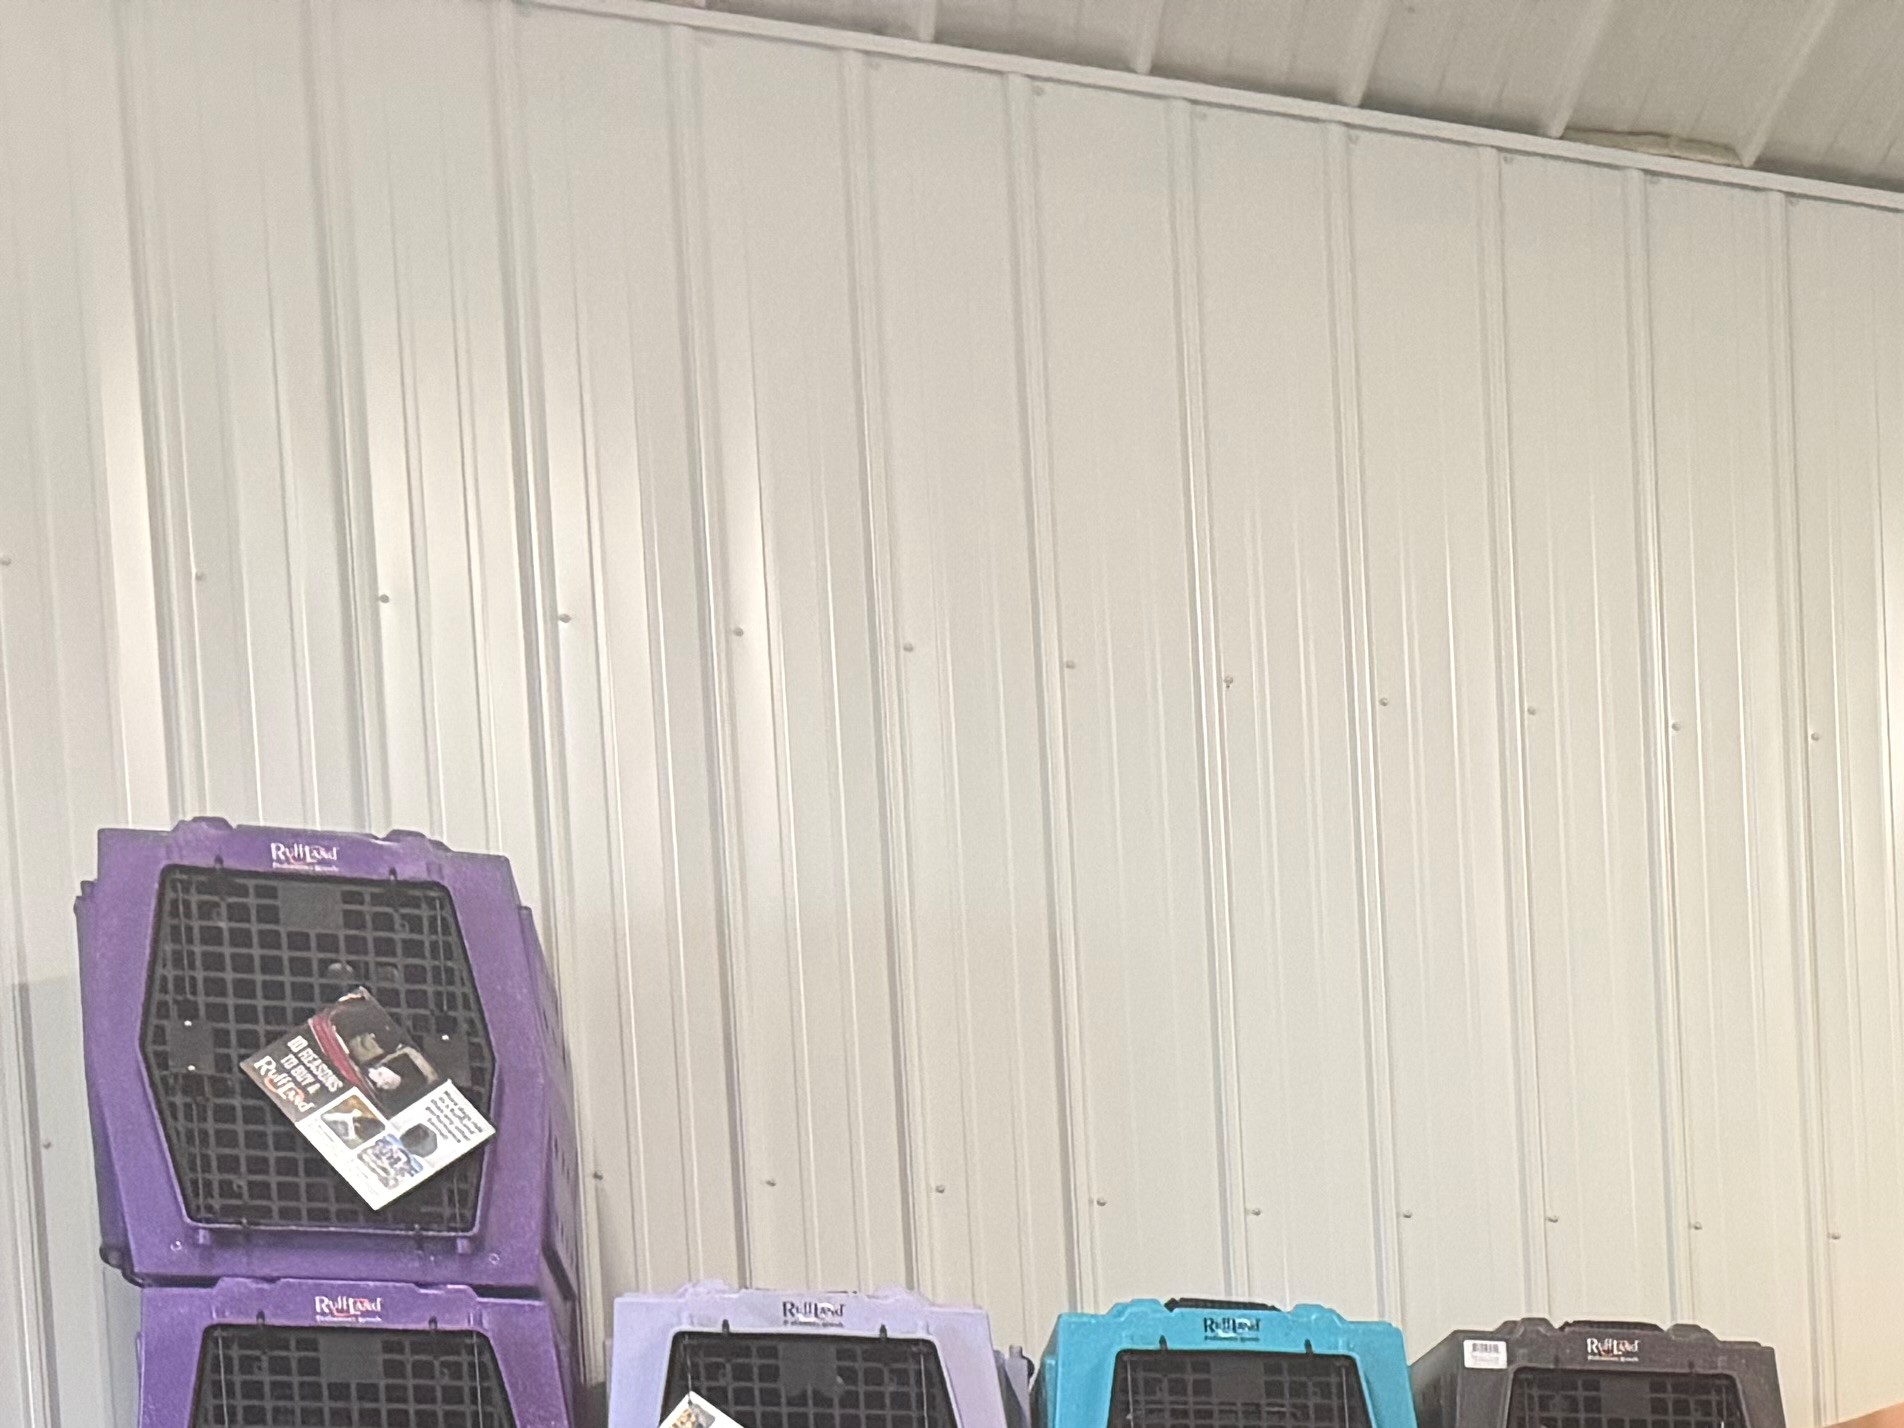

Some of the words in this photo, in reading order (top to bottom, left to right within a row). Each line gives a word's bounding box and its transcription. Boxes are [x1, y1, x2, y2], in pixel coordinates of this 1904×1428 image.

[286, 1034, 309, 1053] 10
[279, 1053, 299, 1069] TO
[289, 1063, 316, 1087] BUY
[305, 1081, 322, 1094] A
[296, 1047, 344, 1093] REASONS
